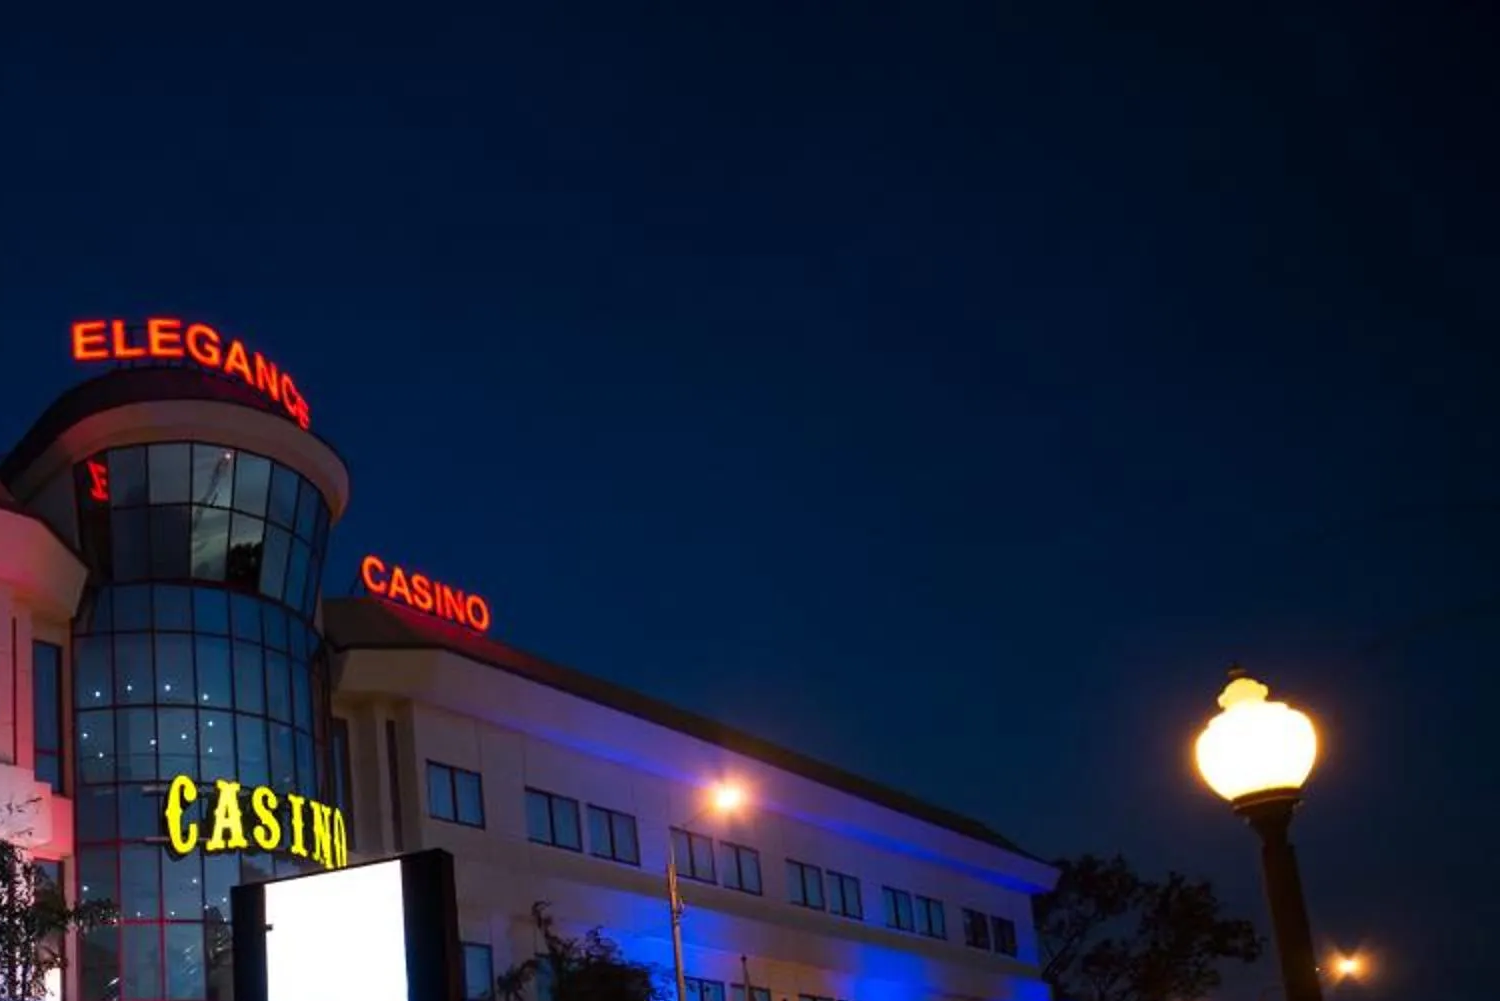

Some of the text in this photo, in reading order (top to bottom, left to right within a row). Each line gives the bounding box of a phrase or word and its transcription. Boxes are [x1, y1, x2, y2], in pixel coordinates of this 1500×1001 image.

[72, 318, 310, 429] ELEGANCE
[361, 555, 490, 632] CASINO
[165, 774, 348, 869] CASINO
